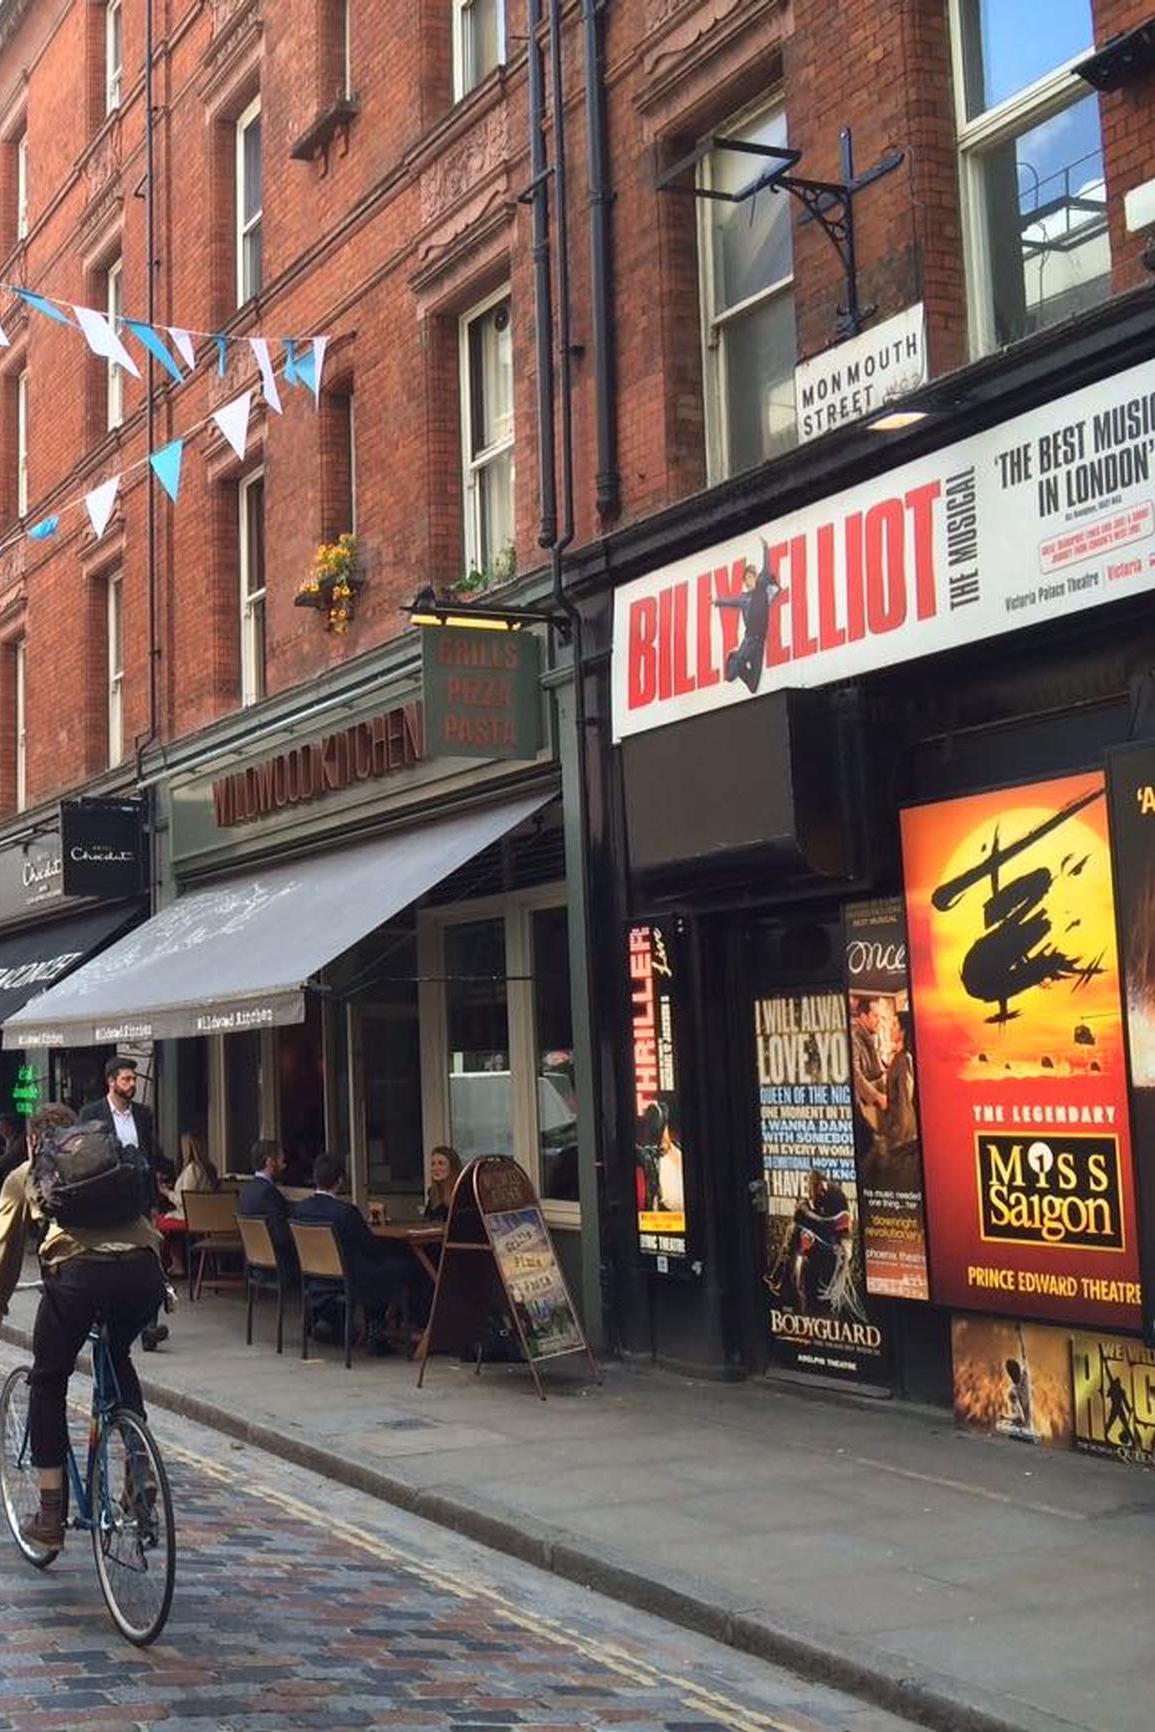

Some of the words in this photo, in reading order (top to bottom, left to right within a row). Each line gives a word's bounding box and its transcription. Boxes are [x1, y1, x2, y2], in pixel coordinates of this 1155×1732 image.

[802, 332, 917, 409] MONMOUTH
[803, 384, 874, 436] STREET
[1038, 420, 1086, 476] BEST
[946, 464, 978, 566] MUSICAL
[1037, 474, 1060, 518] IN
[628, 557, 750, 711] BILLY
[766, 480, 942, 669] ELLIOT
[949, 564, 981, 611] THE
[1038, 582, 1066, 603] Palace
[1066, 571, 1100, 596] Theatre
[439, 637, 520, 669] GRILLS
[448, 676, 514, 708] PIZZA
[322, 701, 426, 791] KITCHEN
[444, 714, 517, 751] PASTA
[629, 926, 658, 1117] THRILLER
[754, 1000, 760, 1034] I
[762, 998, 799, 1034] WILL
[757, 1034, 811, 1085] LOVE
[760, 1086, 792, 1104] QUEEN
[793, 1085, 807, 1104] OF
[808, 1085, 828, 1104] THE
[768, 1119, 815, 1131] WANNA
[973, 1105, 1005, 1122] THE
[1012, 1105, 1116, 1124] LEGENDARY
[762, 1131, 794, 1143] WITH
[780, 1143, 816, 1155] EVERY
[764, 1169, 770, 1196] I
[772, 1169, 809, 1197] HAVE
[989, 1184, 1115, 1241] Saigon
[968, 1266, 1015, 1291] PRINCE
[1018, 1271, 1078, 1297] EDWARD
[1081, 1278, 1142, 1305] THEATRE
[770, 1309, 882, 1348] BODYGUARD
